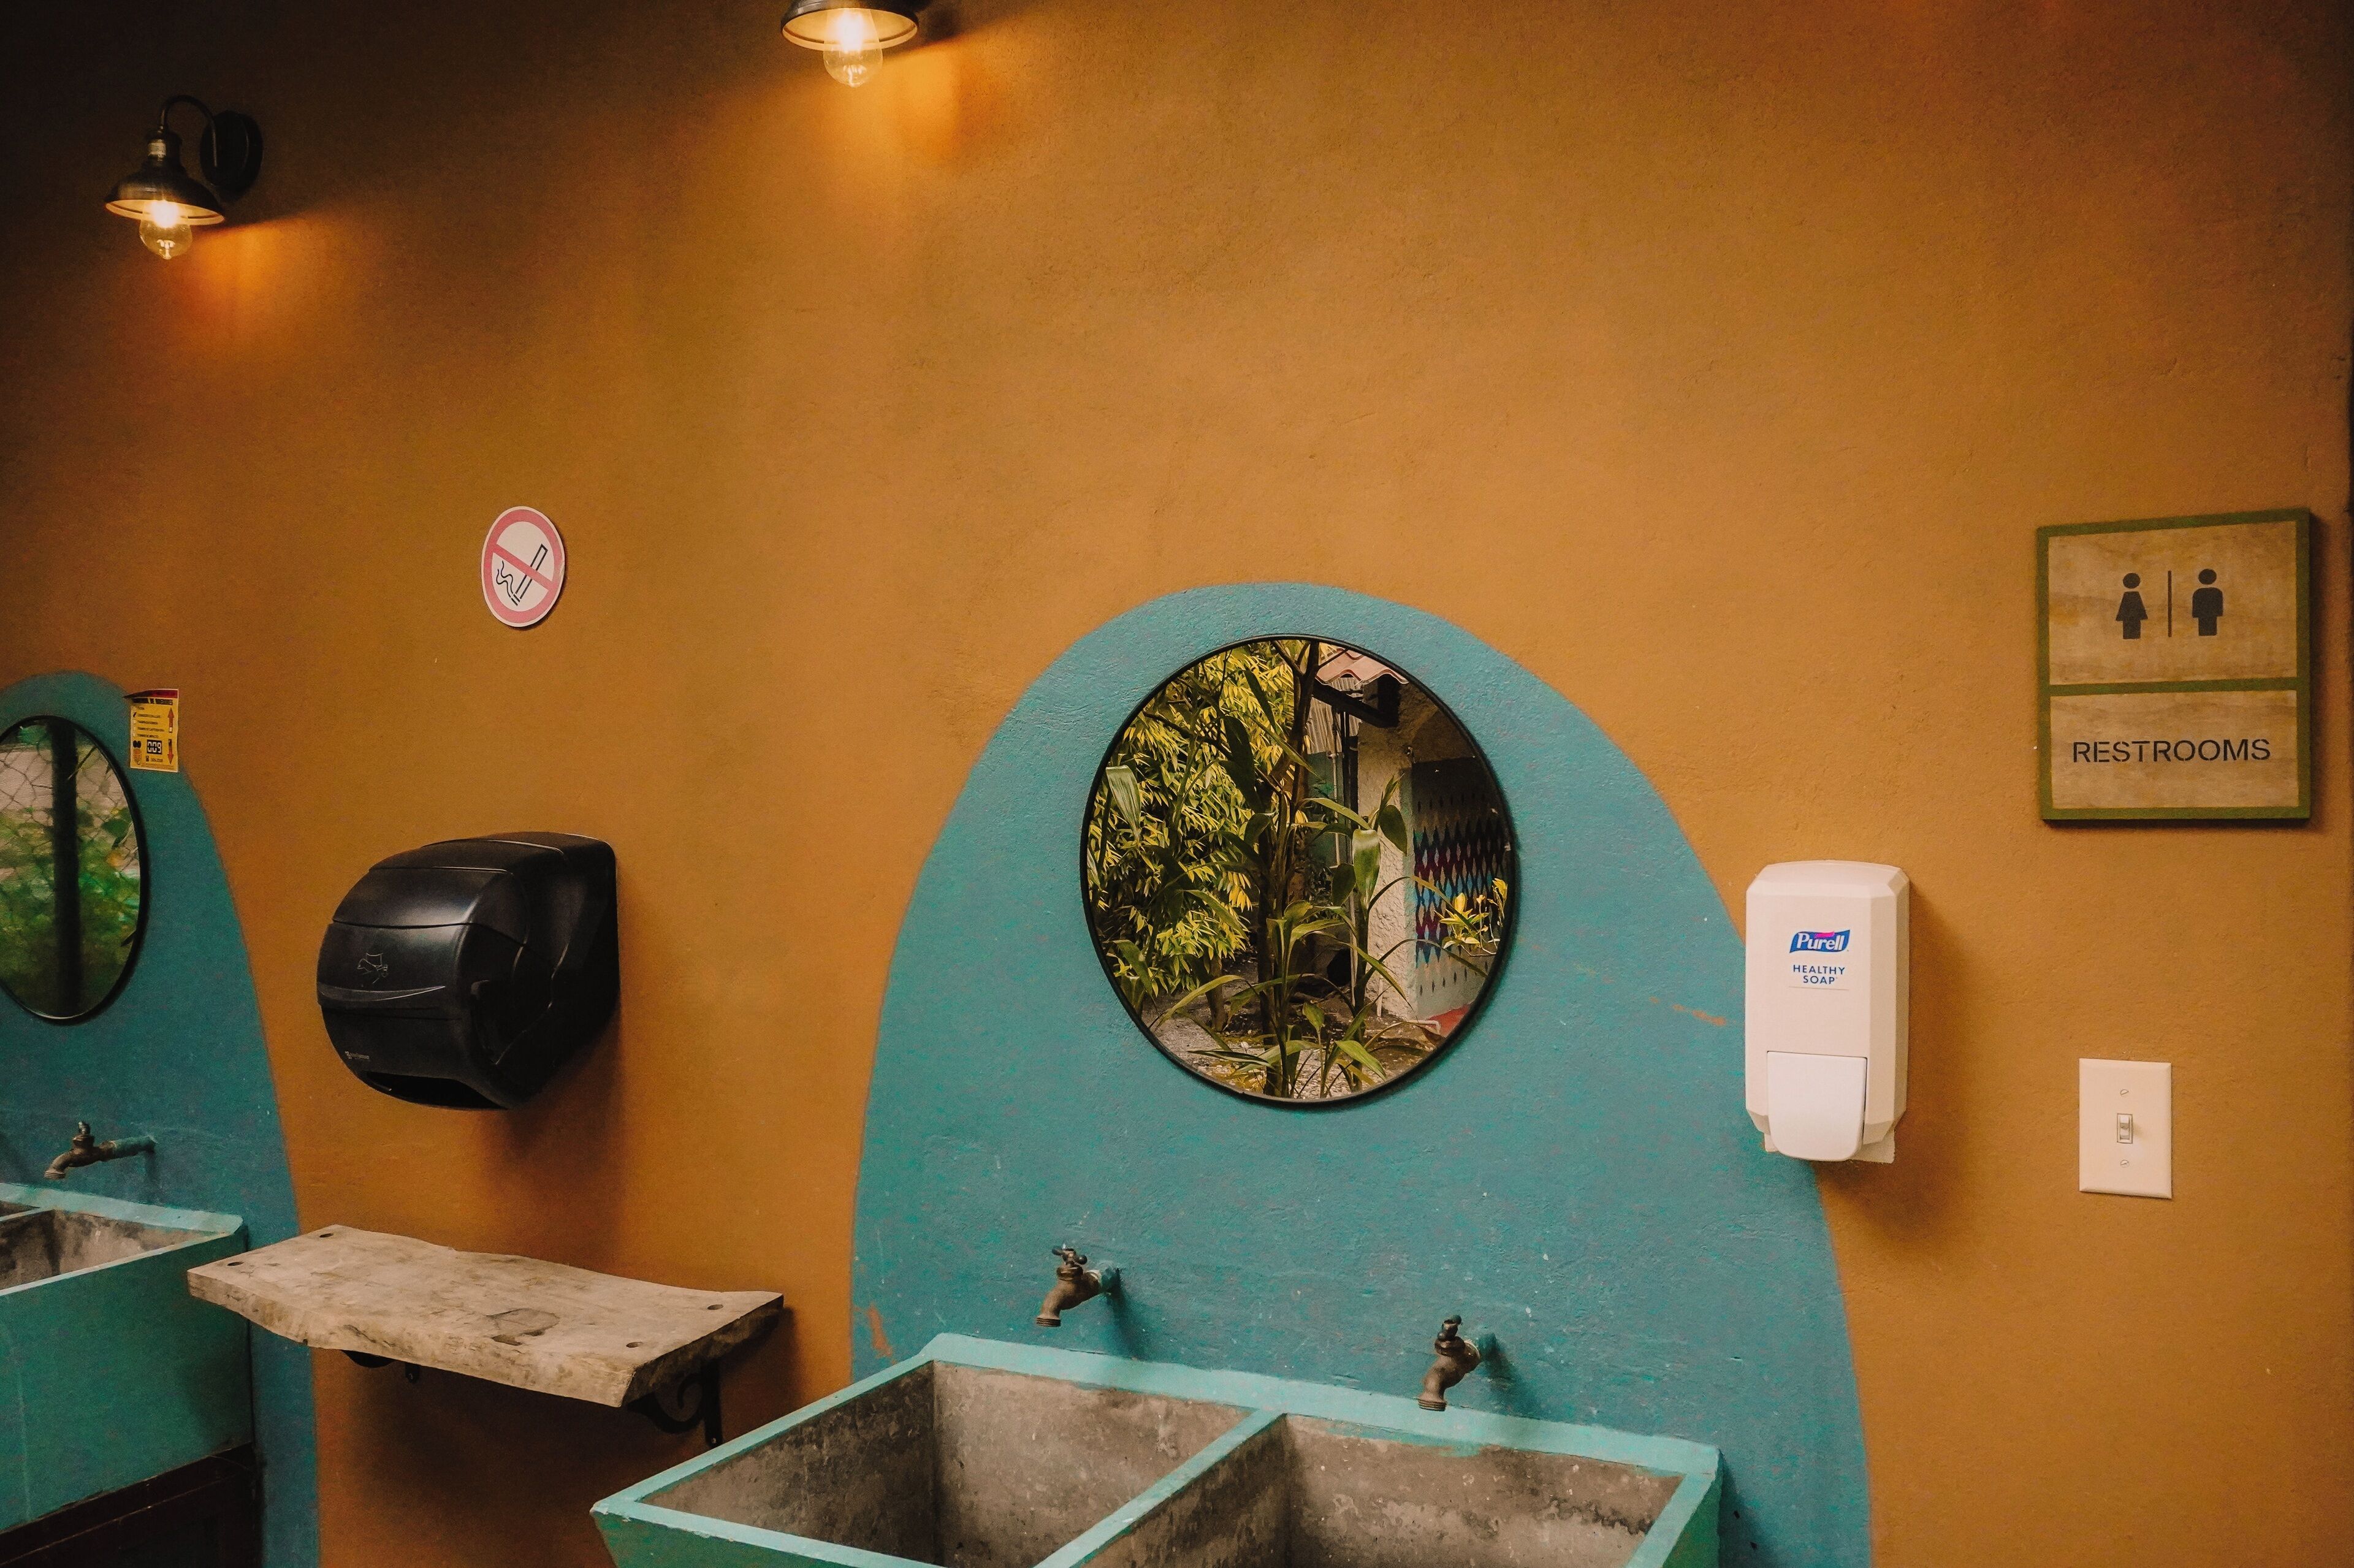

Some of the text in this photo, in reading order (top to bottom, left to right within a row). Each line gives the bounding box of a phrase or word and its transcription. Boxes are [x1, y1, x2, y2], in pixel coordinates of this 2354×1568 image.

[147, 741, 162, 753] 009
[2073, 738, 2271, 763] RESTROOMS
[1796, 932, 1845, 951] Purell
[1793, 964, 1845, 975] HEALTHY
[1803, 975, 1835, 984] SOAP
